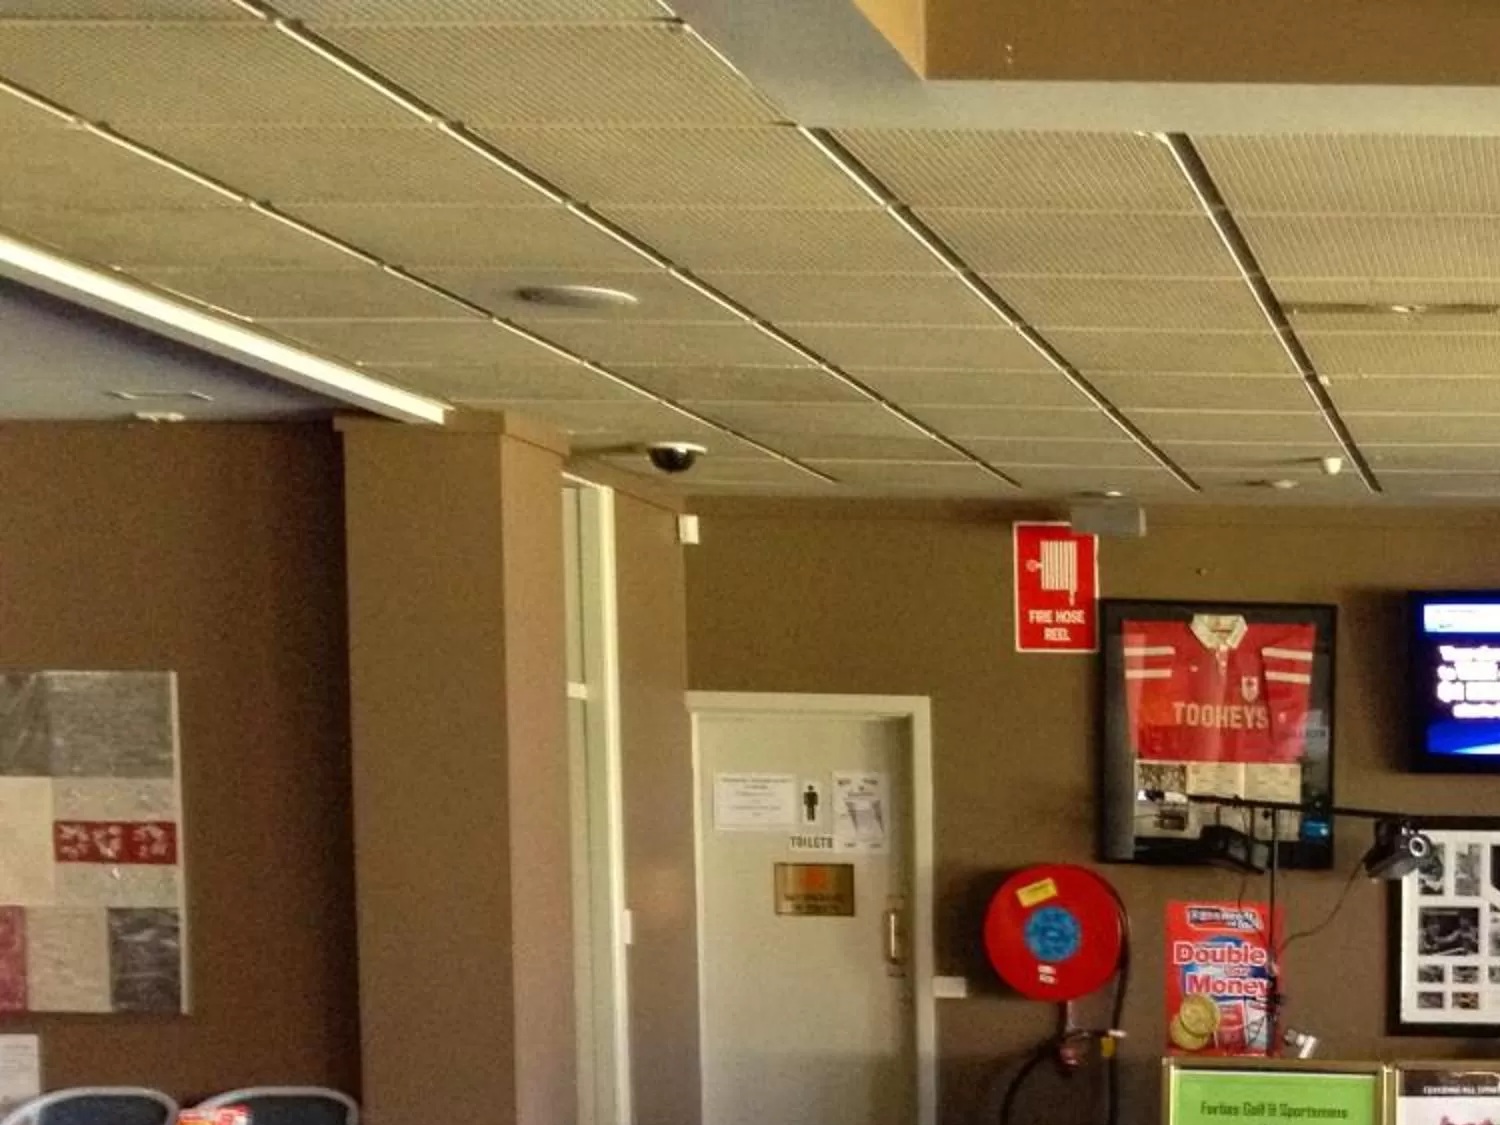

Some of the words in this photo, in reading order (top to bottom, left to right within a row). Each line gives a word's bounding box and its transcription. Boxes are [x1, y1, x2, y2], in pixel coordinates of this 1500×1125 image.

[1028, 609, 1053, 624] FIRE
[1055, 609, 1085, 624] HOSE
[1043, 627, 1072, 641] REEL
[1172, 702, 1269, 729] TOOHEYS
[790, 836, 833, 849] TOILETS
[1174, 940, 1267, 966] Double
[1185, 972, 1269, 996] Money
